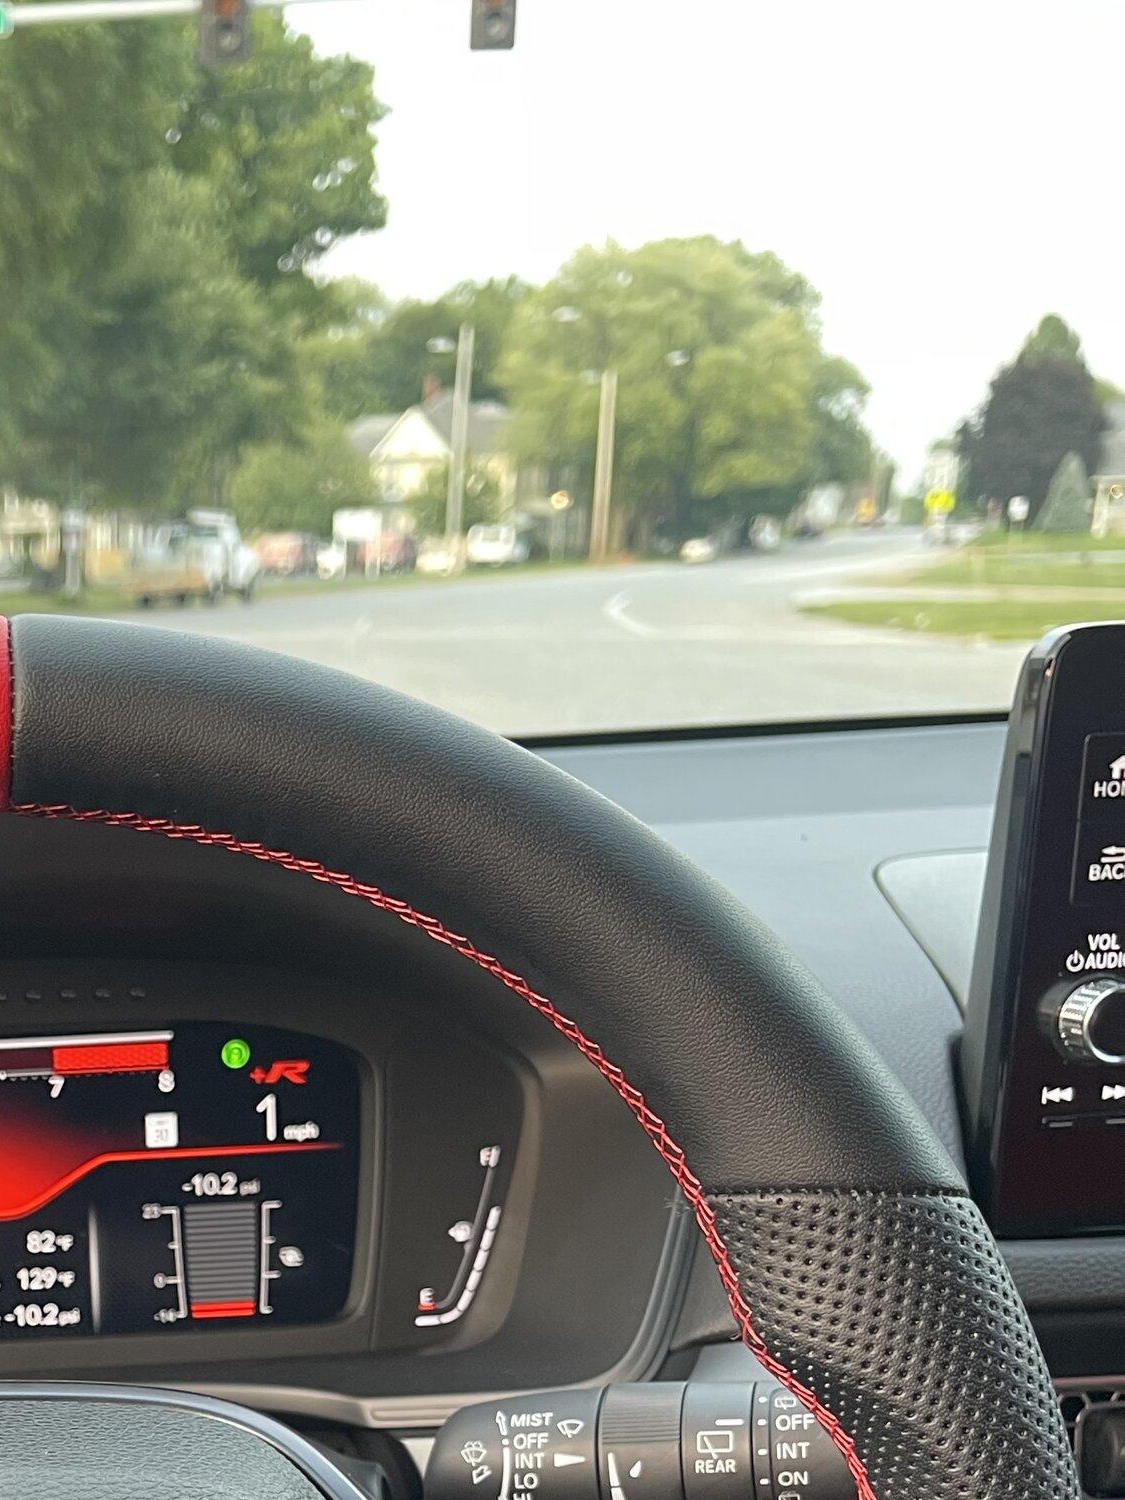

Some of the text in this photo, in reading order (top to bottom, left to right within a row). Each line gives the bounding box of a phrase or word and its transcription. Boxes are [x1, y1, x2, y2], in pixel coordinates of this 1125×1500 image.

[1093, 780, 1125, 798] HO
[1087, 862, 1125, 882] BAC
[1087, 933, 1121, 951] VOL
[1084, 951, 1125, 970] AUDI
[47, 1075, 66, 1099] 7
[158, 1069, 175, 1093] 8
[255, 1093, 277, 1142] 1
[510, 1411, 554, 1428] MIST
[775, 1414, 817, 1432] OFF
[512, 1431, 549, 1450] OFF
[775, 1441, 812, 1461] INT
[514, 1453, 546, 1470] INT
[694, 1457, 737, 1475] REAR
[513, 1472, 539, 1491] LO
[777, 1470, 810, 1487] ON
